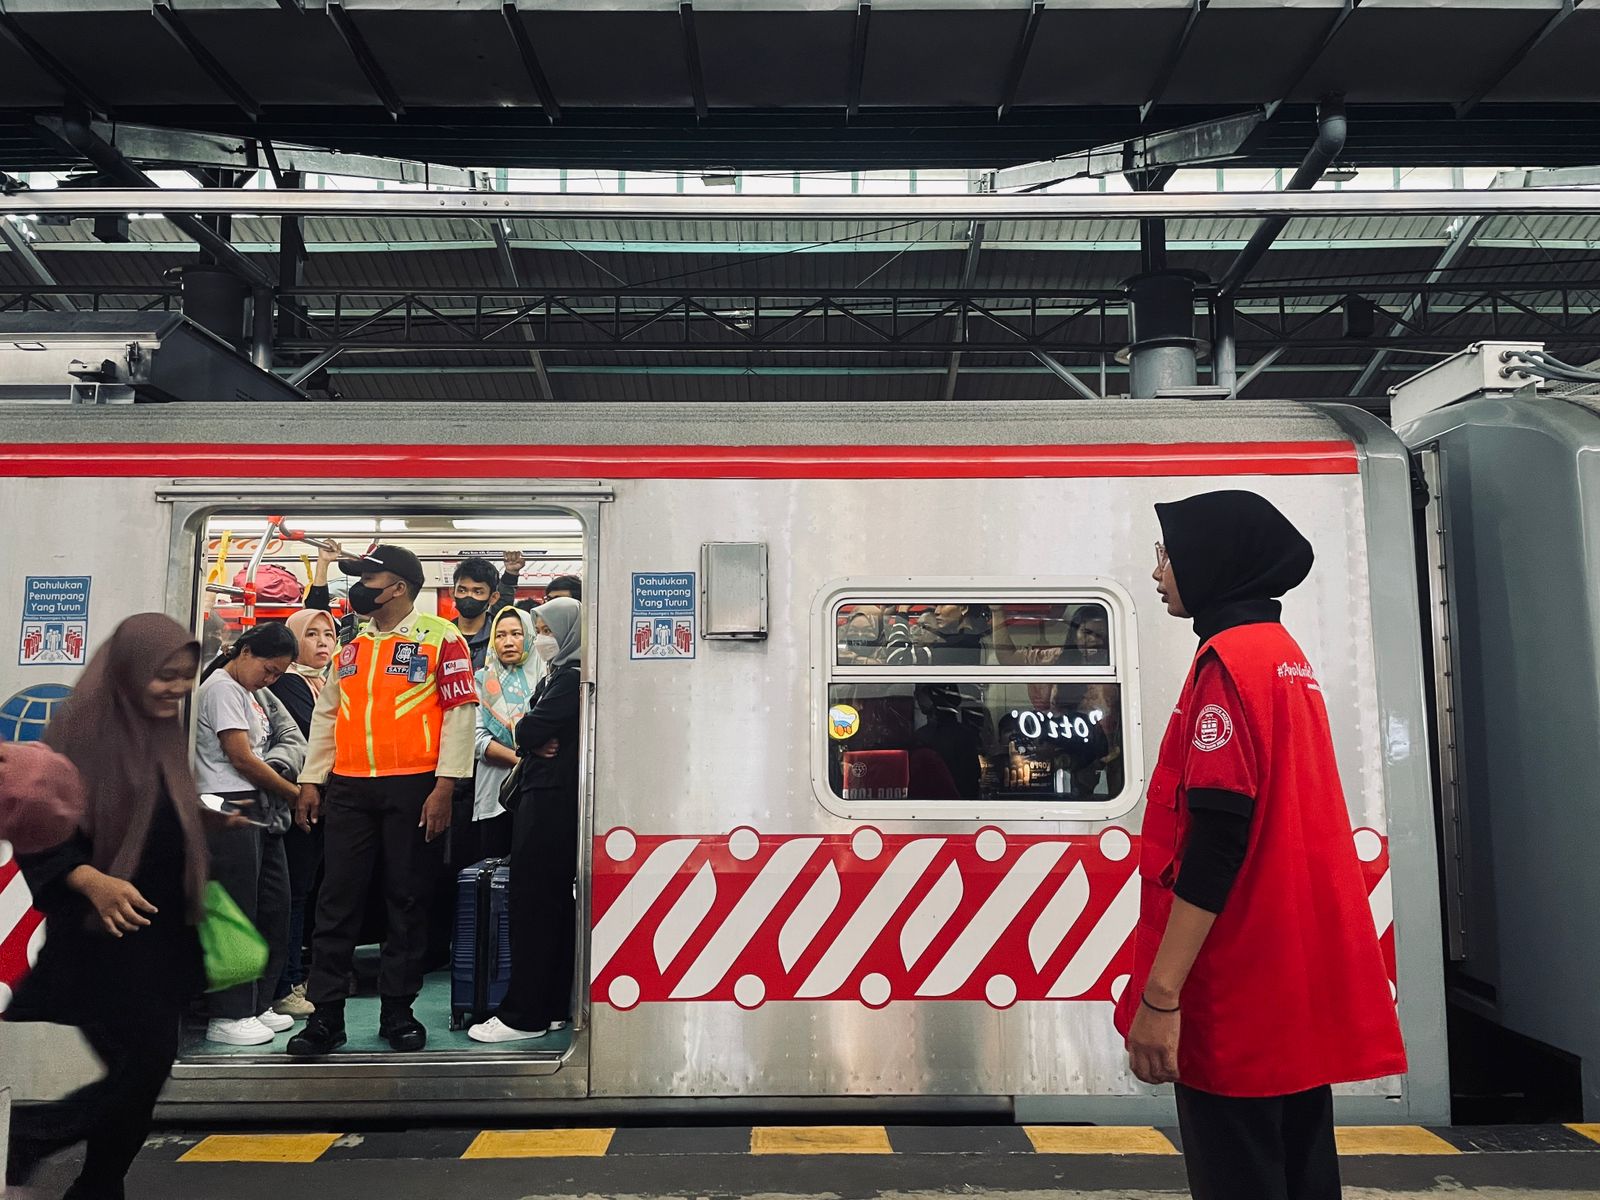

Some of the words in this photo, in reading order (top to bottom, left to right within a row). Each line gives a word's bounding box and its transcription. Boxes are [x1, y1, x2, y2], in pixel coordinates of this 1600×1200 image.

[32, 581, 83, 589] Dahulukan
[639, 577, 688, 585] Dahulukan
[29, 592, 85, 601] Penumpang
[636, 588, 691, 597] Penumpang
[31, 603, 55, 613] Yang
[57, 602, 80, 611] Turun
[639, 598, 663, 608] Yang
[664, 598, 688, 607] Turun
